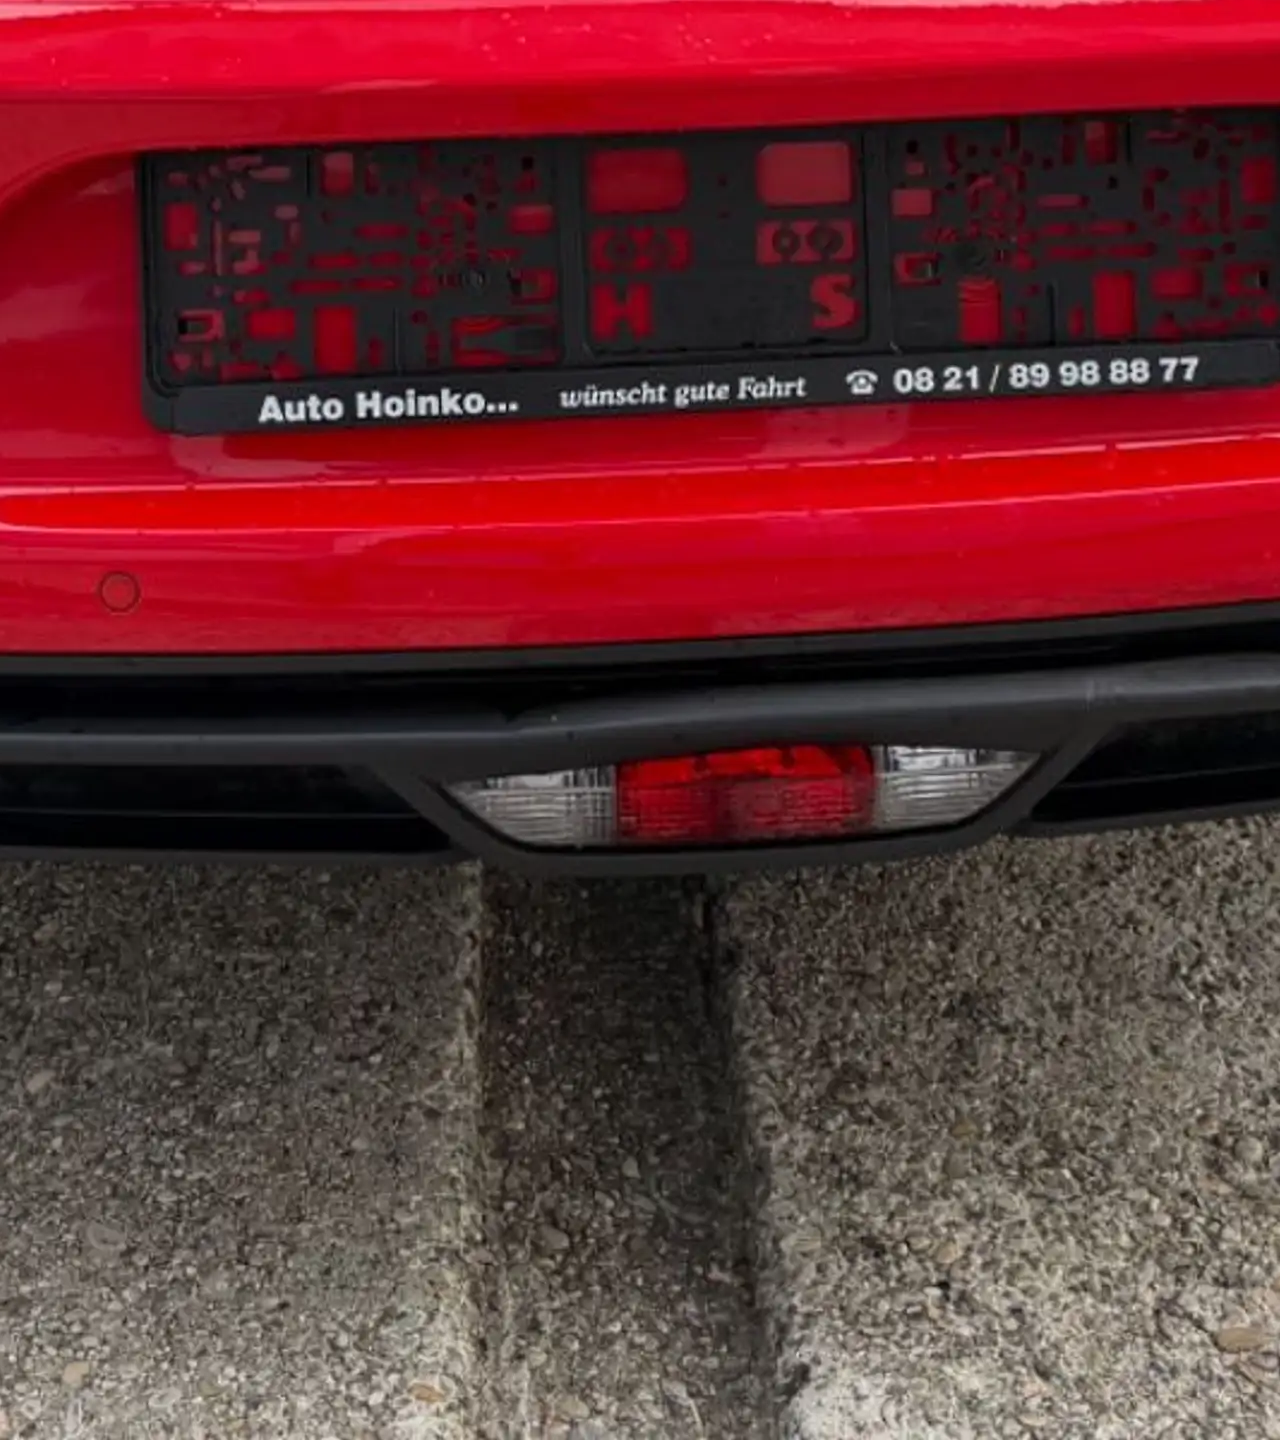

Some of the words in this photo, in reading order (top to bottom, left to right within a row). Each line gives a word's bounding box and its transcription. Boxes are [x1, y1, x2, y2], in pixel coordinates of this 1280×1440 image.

[258, 393, 344, 423] Auto
[559, 380, 667, 408] wünscht
[674, 379, 730, 408] gute
[737, 376, 807, 400] Fahrt
[892, 366, 935, 394] 08
[943, 365, 980, 391] 21
[988, 363, 1001, 393] /
[1008, 362, 1051, 389] 89
[1058, 360, 1101, 387] 98
[1108, 357, 1151, 385] 88
[1158, 356, 1200, 383] 77
